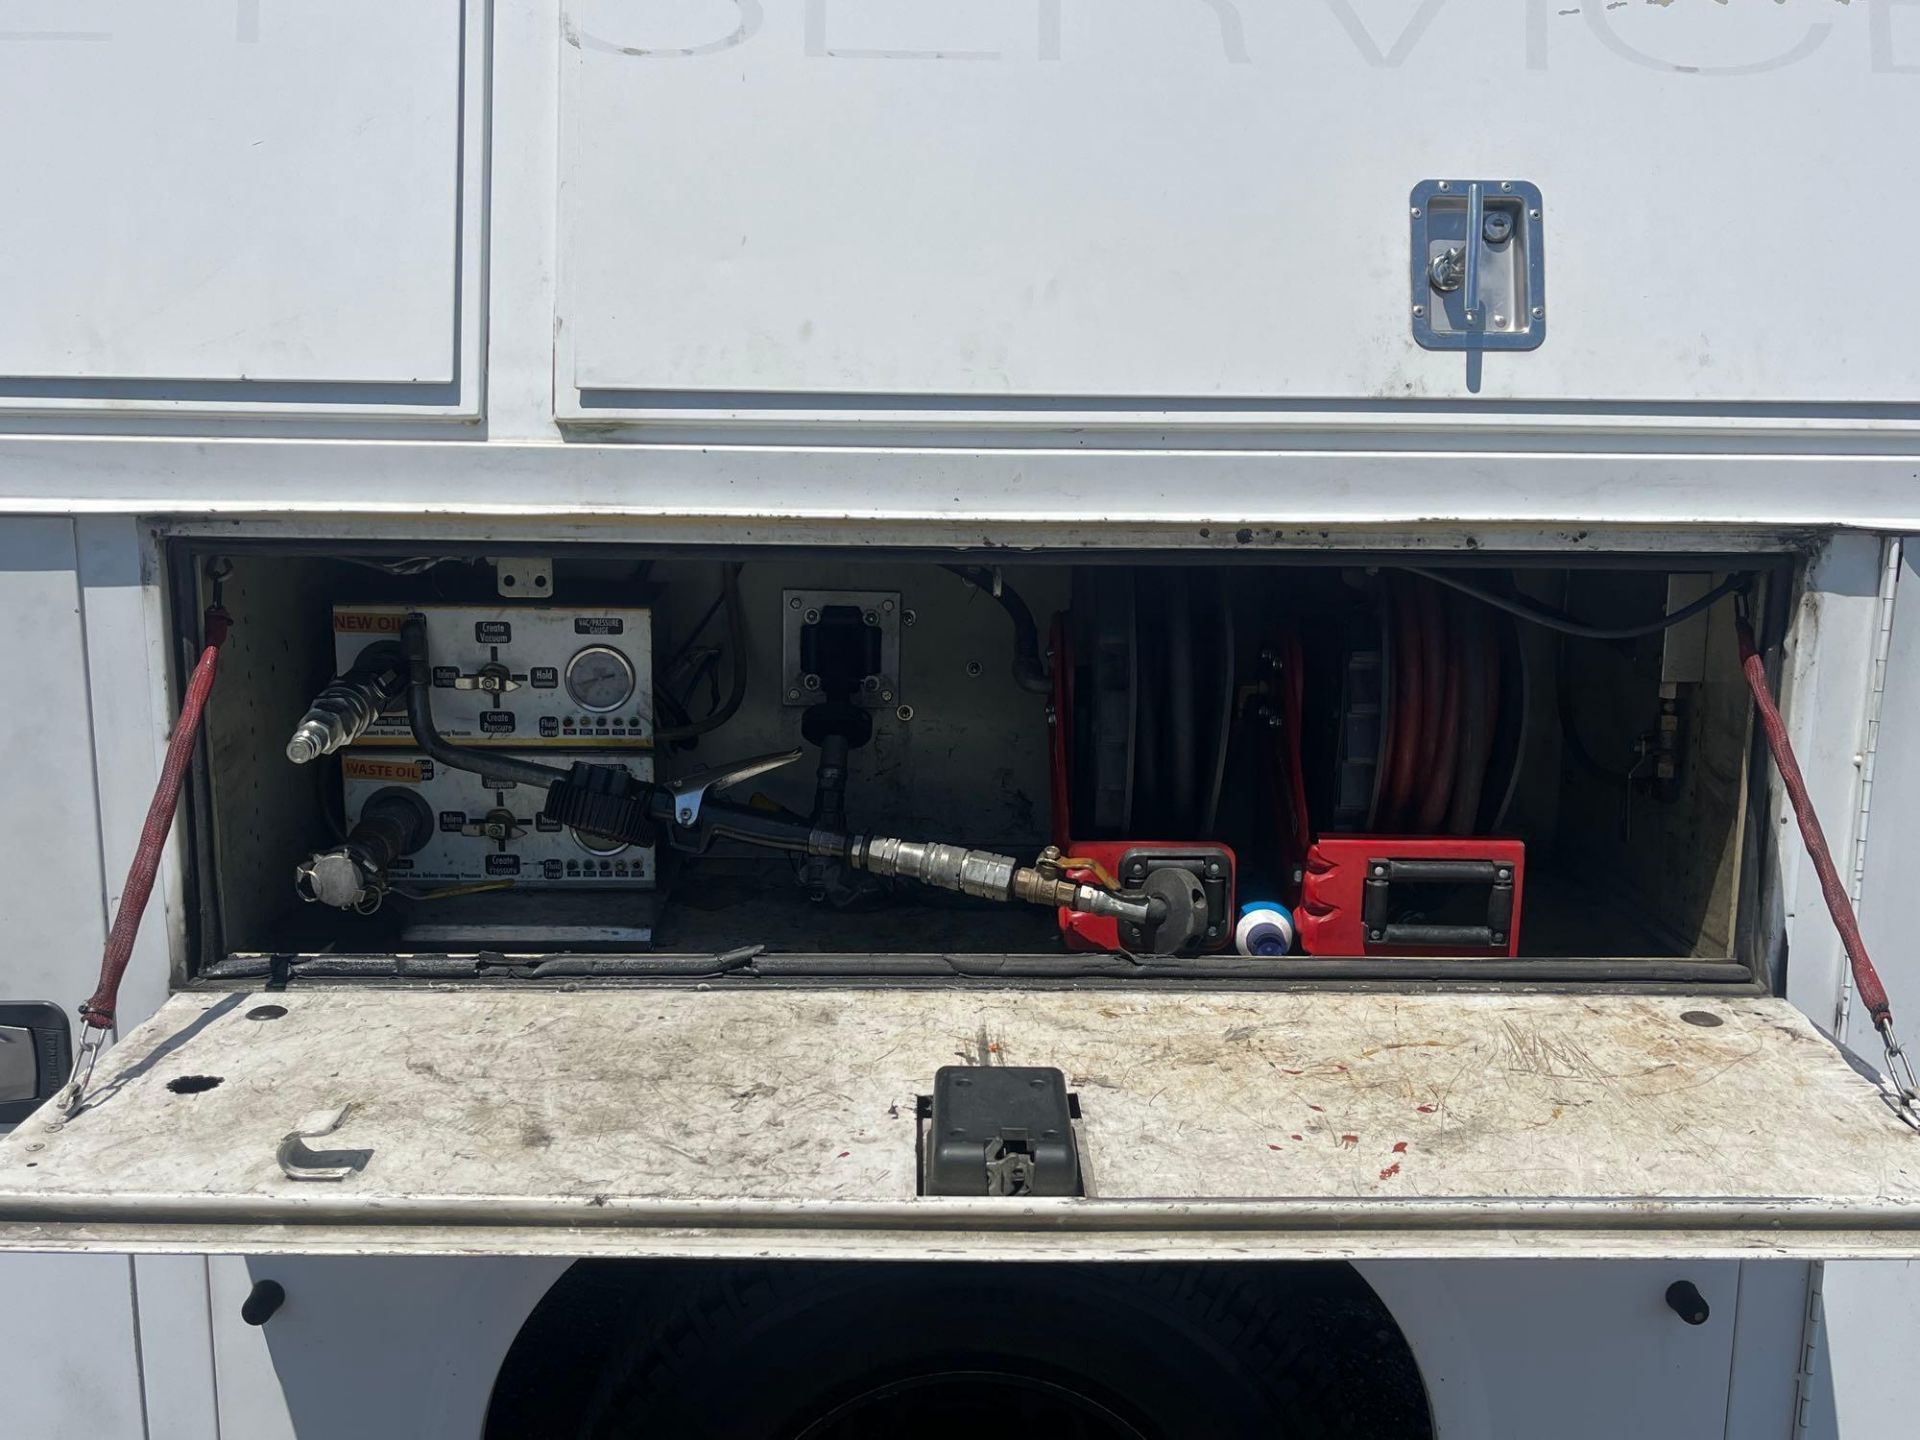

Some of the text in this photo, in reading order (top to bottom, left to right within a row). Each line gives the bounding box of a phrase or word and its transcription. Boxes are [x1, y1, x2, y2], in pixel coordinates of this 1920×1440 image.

[335, 615, 372, 629] NEW
[482, 622, 505, 633] Create
[479, 632, 508, 643] Vacuum
[536, 668, 553, 679] Hold
[486, 712, 509, 722] Create
[483, 722, 512, 732] Pressure
[540, 719, 557, 727] Fluid
[540, 727, 558, 736] Level
[346, 763, 393, 777] WASTE
[395, 766, 418, 779] OIL
